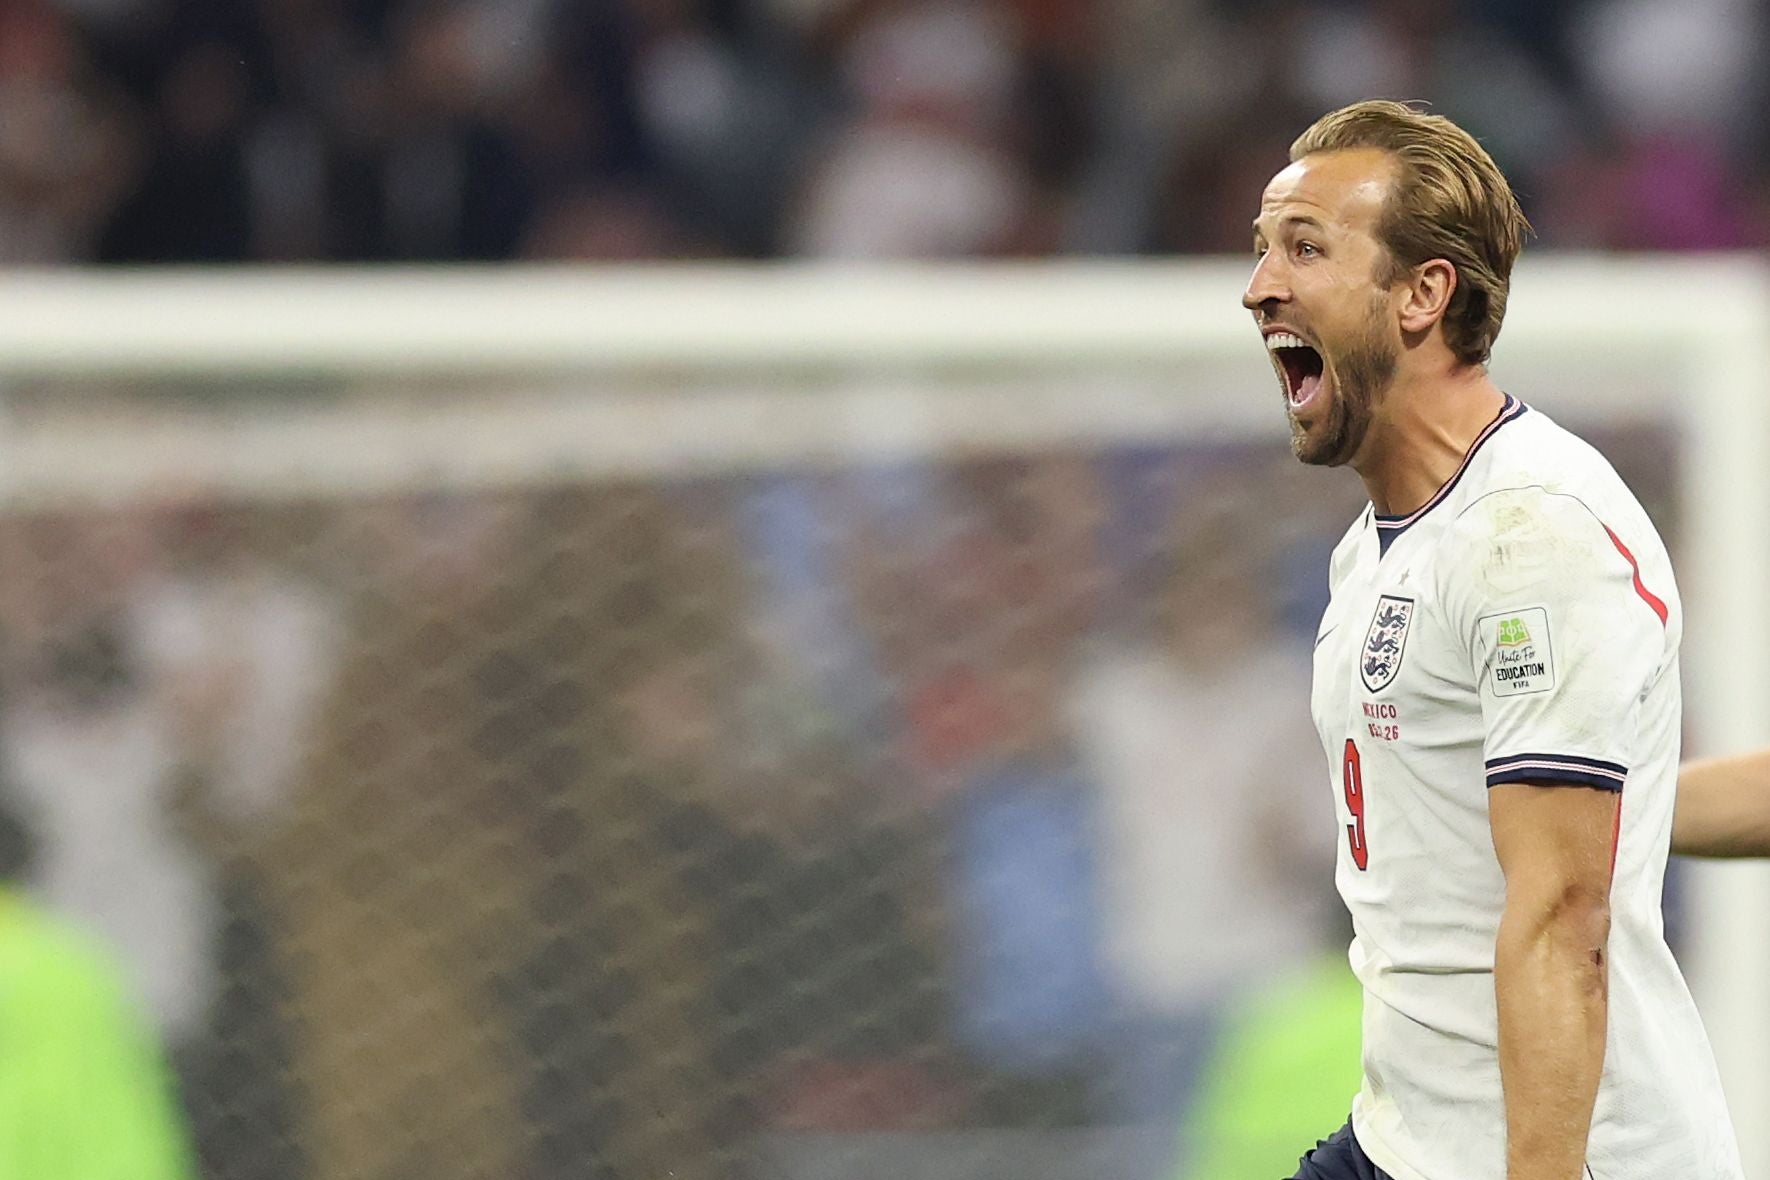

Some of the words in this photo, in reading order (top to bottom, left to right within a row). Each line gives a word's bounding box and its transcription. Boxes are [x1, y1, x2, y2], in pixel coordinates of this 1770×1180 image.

[1497, 649, 1521, 665] Unite
[1521, 645, 1536, 661] For
[1496, 662, 1545, 681] EDUCATION
[1513, 680, 1530, 689] FIFA
[1361, 702, 1397, 719] MXICO
[1344, 738, 1369, 872] 9
